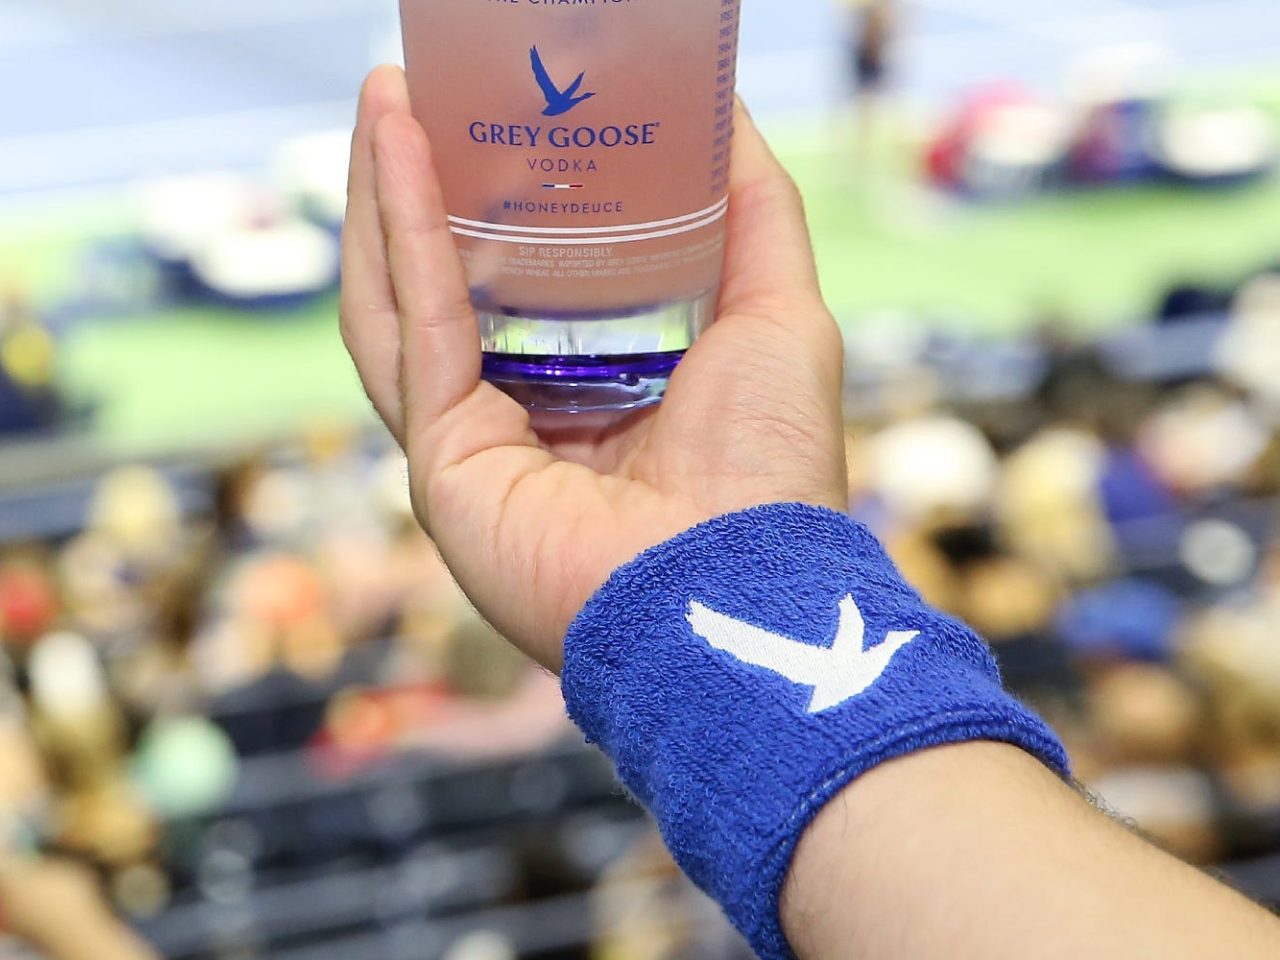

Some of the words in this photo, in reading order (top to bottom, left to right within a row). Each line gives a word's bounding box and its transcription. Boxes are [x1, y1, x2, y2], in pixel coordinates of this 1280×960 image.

[469, 121, 541, 147] GREY
[548, 123, 656, 147] GOOSE
[527, 158, 597, 172] VODKA
[503, 201, 622, 214] #HONEYDEUCE
[519, 245, 536, 256] SIP
